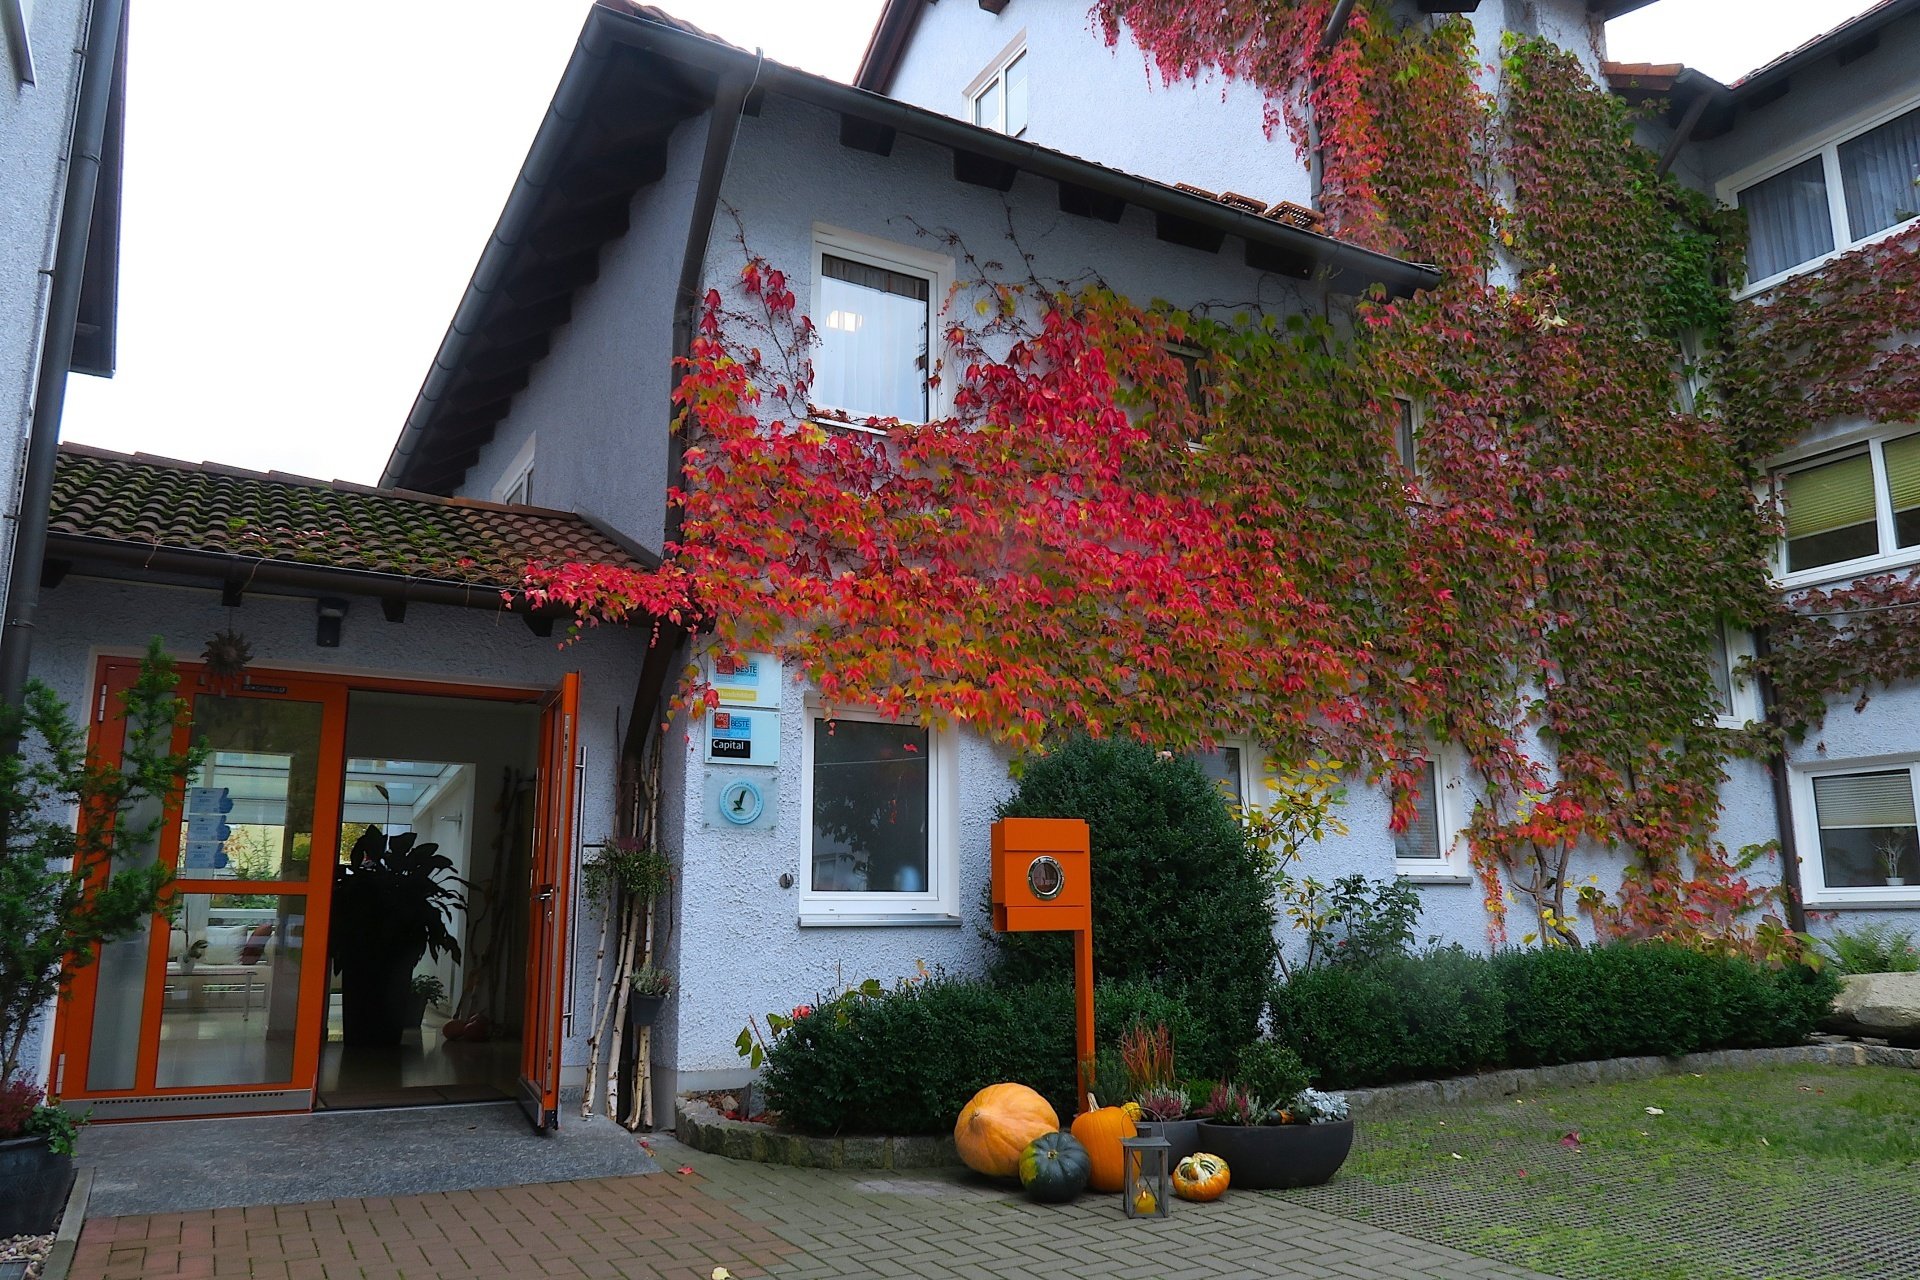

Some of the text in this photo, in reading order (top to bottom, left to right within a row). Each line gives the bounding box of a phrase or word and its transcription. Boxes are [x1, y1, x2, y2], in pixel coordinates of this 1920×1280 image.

[735, 665, 757, 674] BESTE
[731, 720, 750, 728] BESTE
[712, 740, 744, 751] Capital
